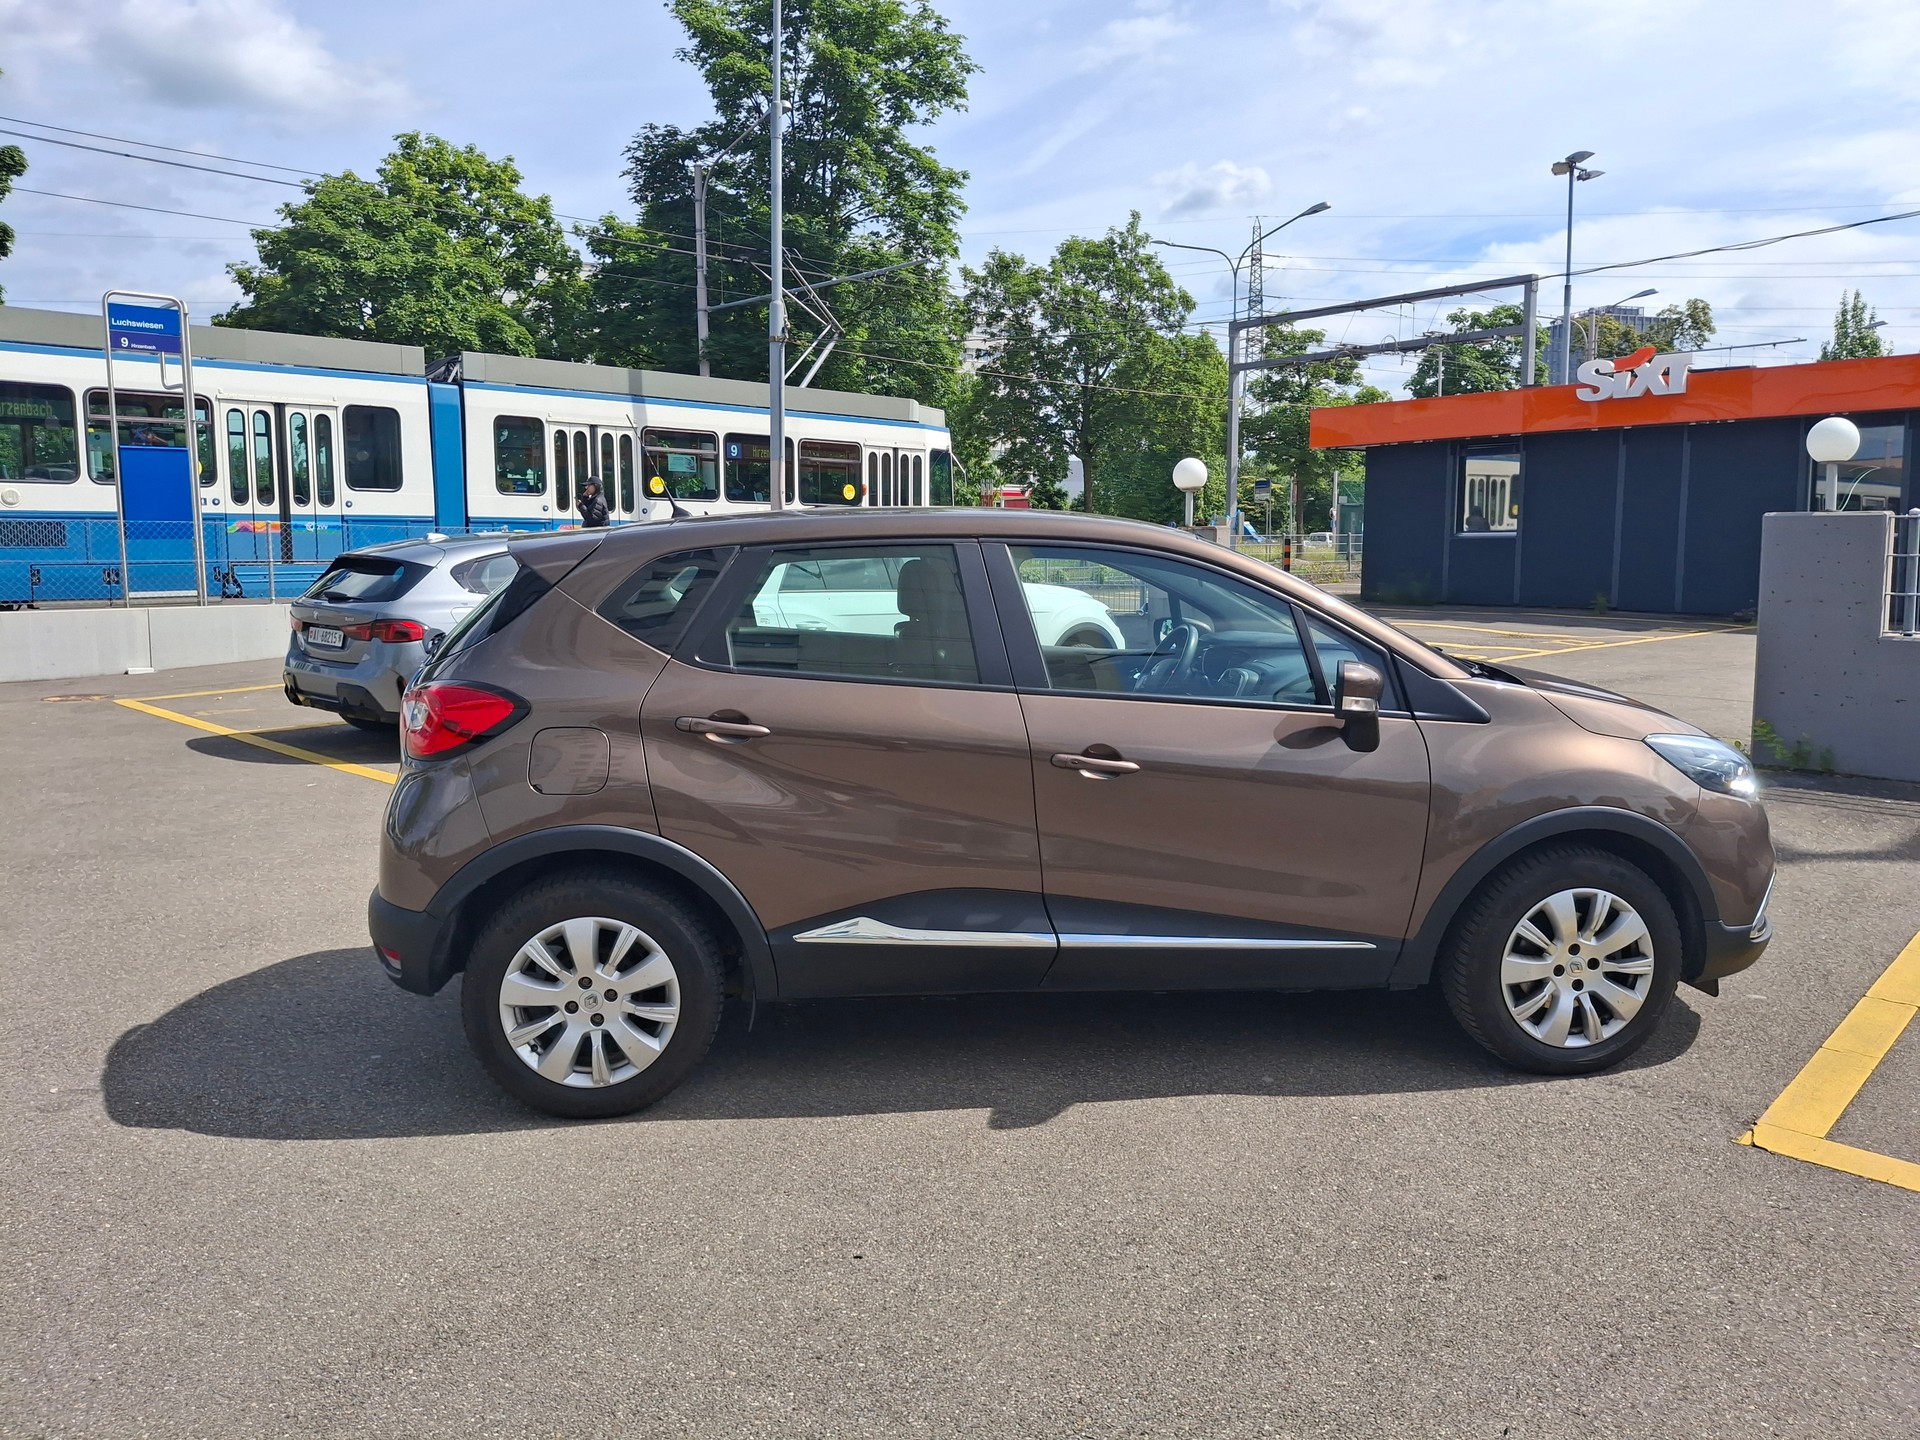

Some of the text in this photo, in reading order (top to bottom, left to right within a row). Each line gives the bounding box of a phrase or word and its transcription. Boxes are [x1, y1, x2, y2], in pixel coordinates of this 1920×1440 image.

[111, 317, 164, 330] Luchswiesen
[120, 336, 129, 347] 9
[730, 444, 738, 457] 9
